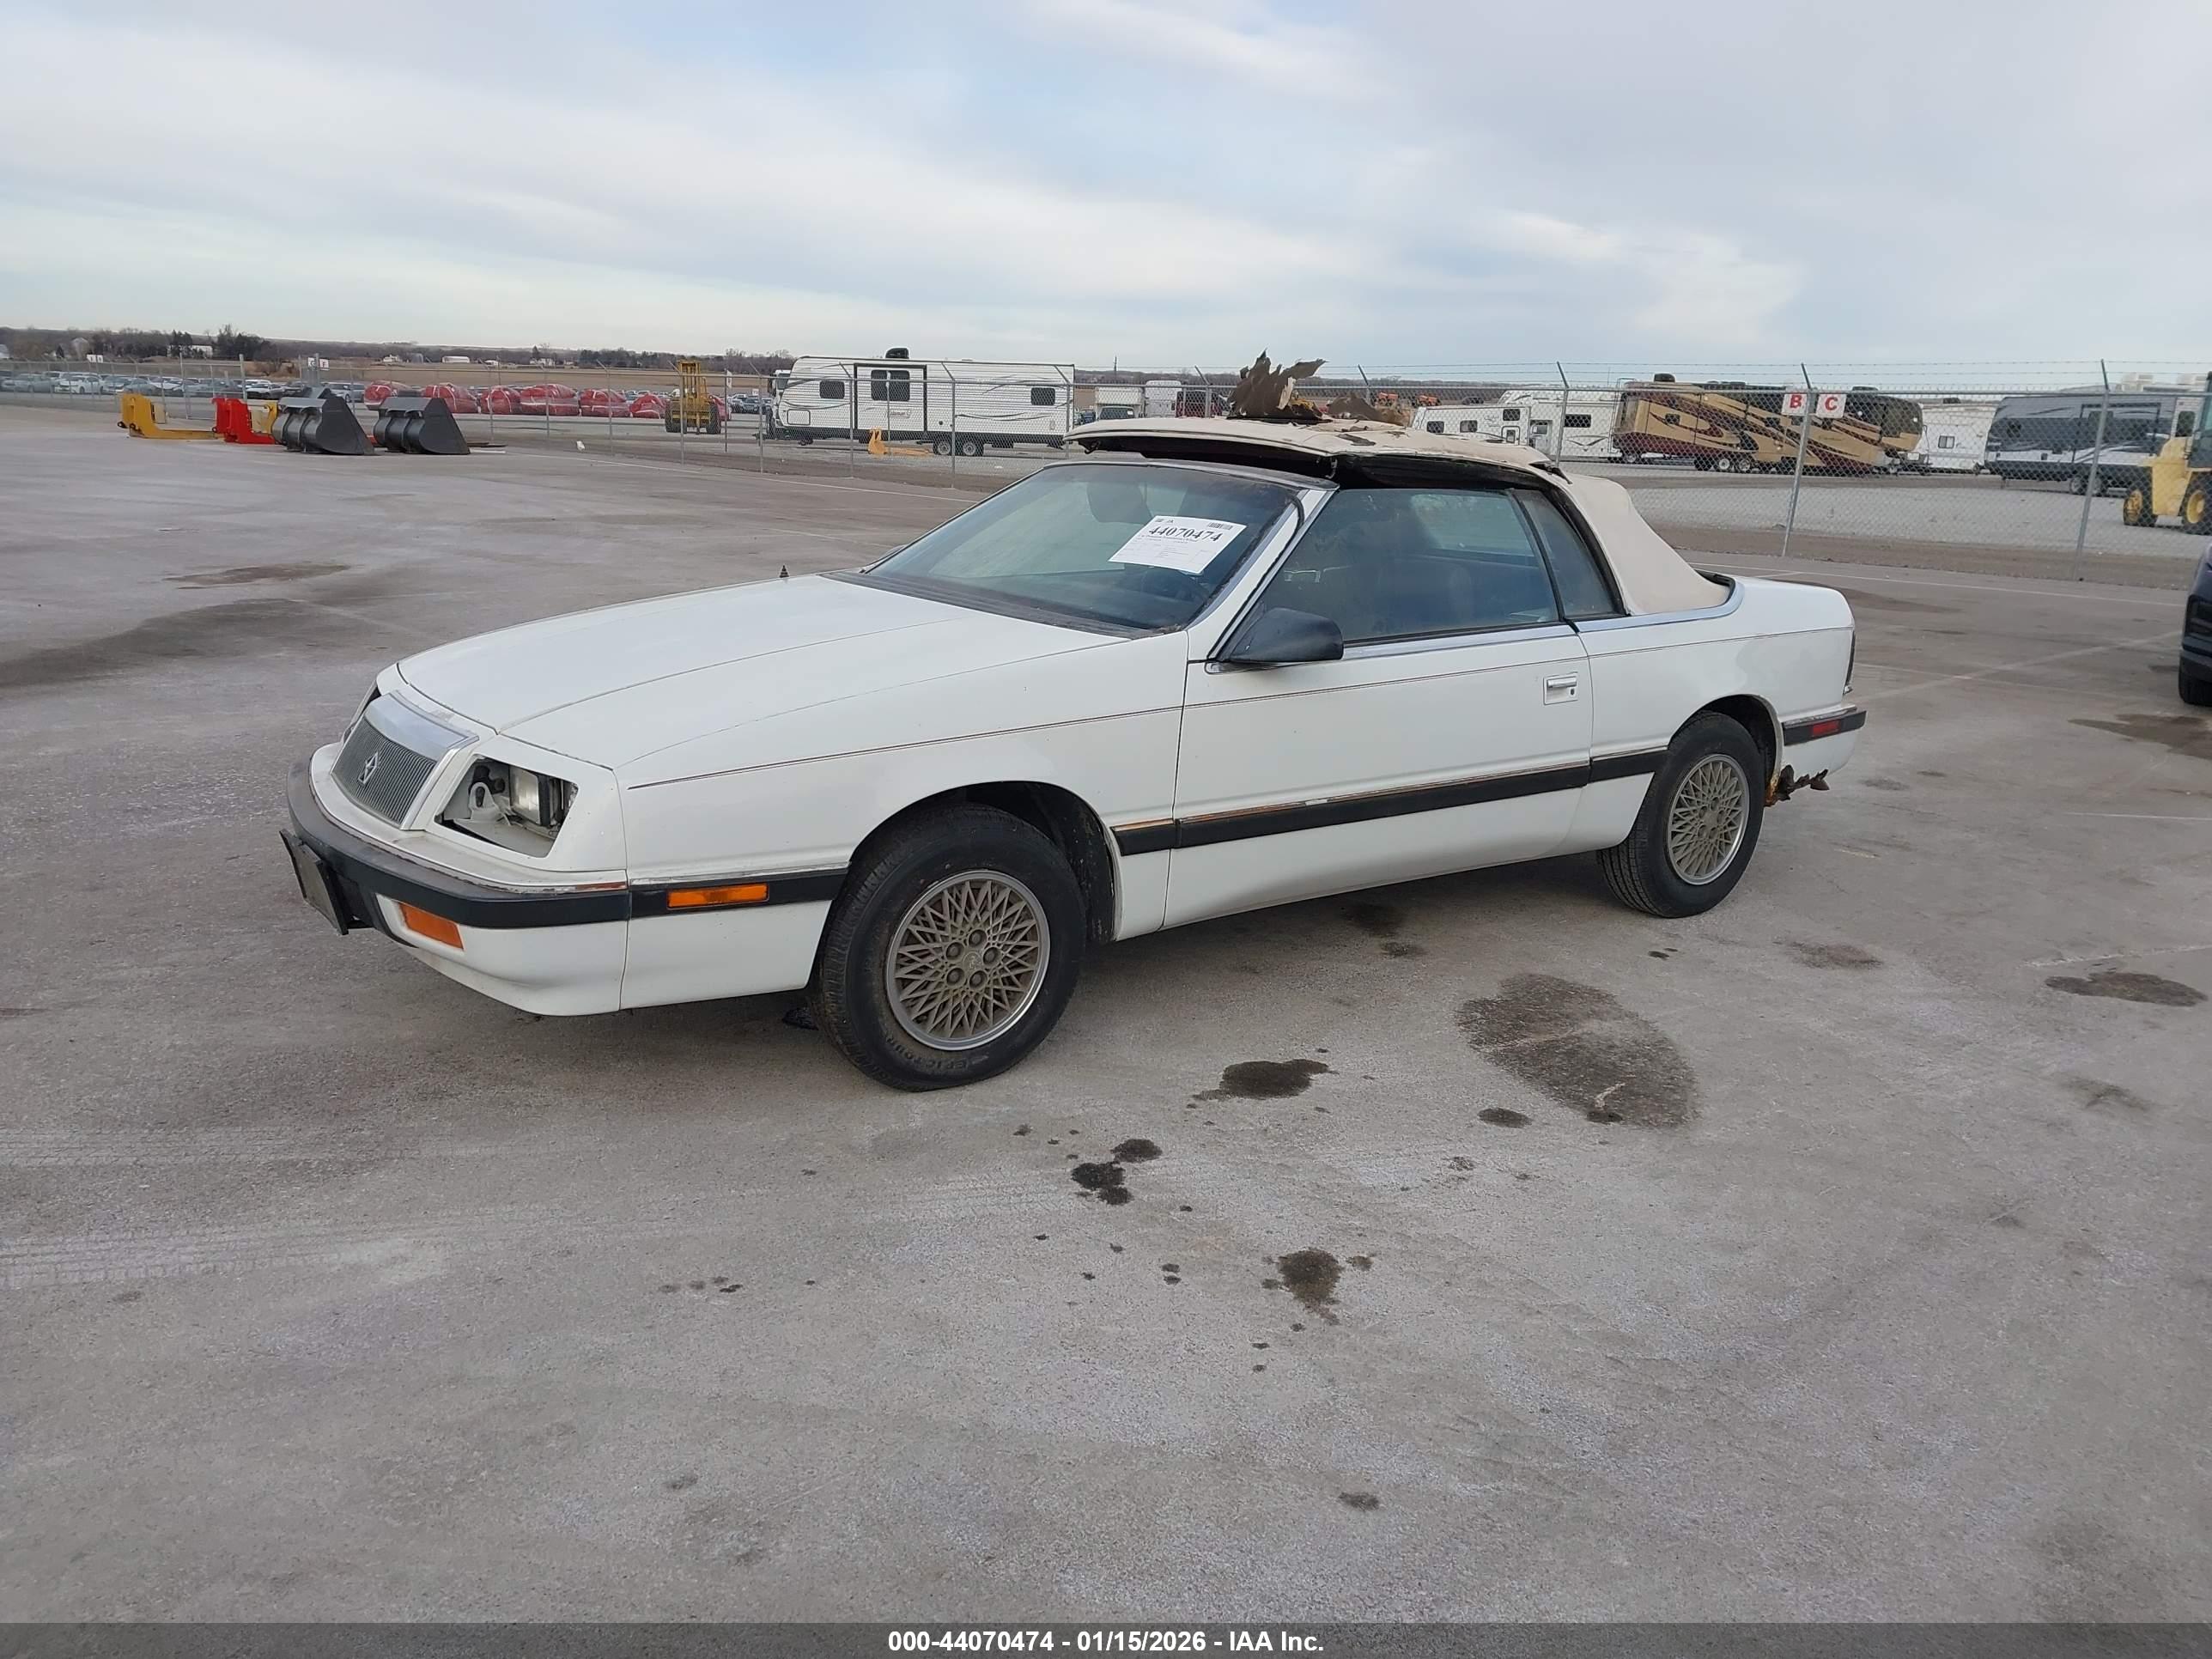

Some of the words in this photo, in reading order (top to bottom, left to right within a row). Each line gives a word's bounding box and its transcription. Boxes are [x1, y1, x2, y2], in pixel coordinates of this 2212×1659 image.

[1790, 394, 1802, 409] B
[1825, 397, 1838, 410] C
[1149, 526, 1224, 542] 44070474
